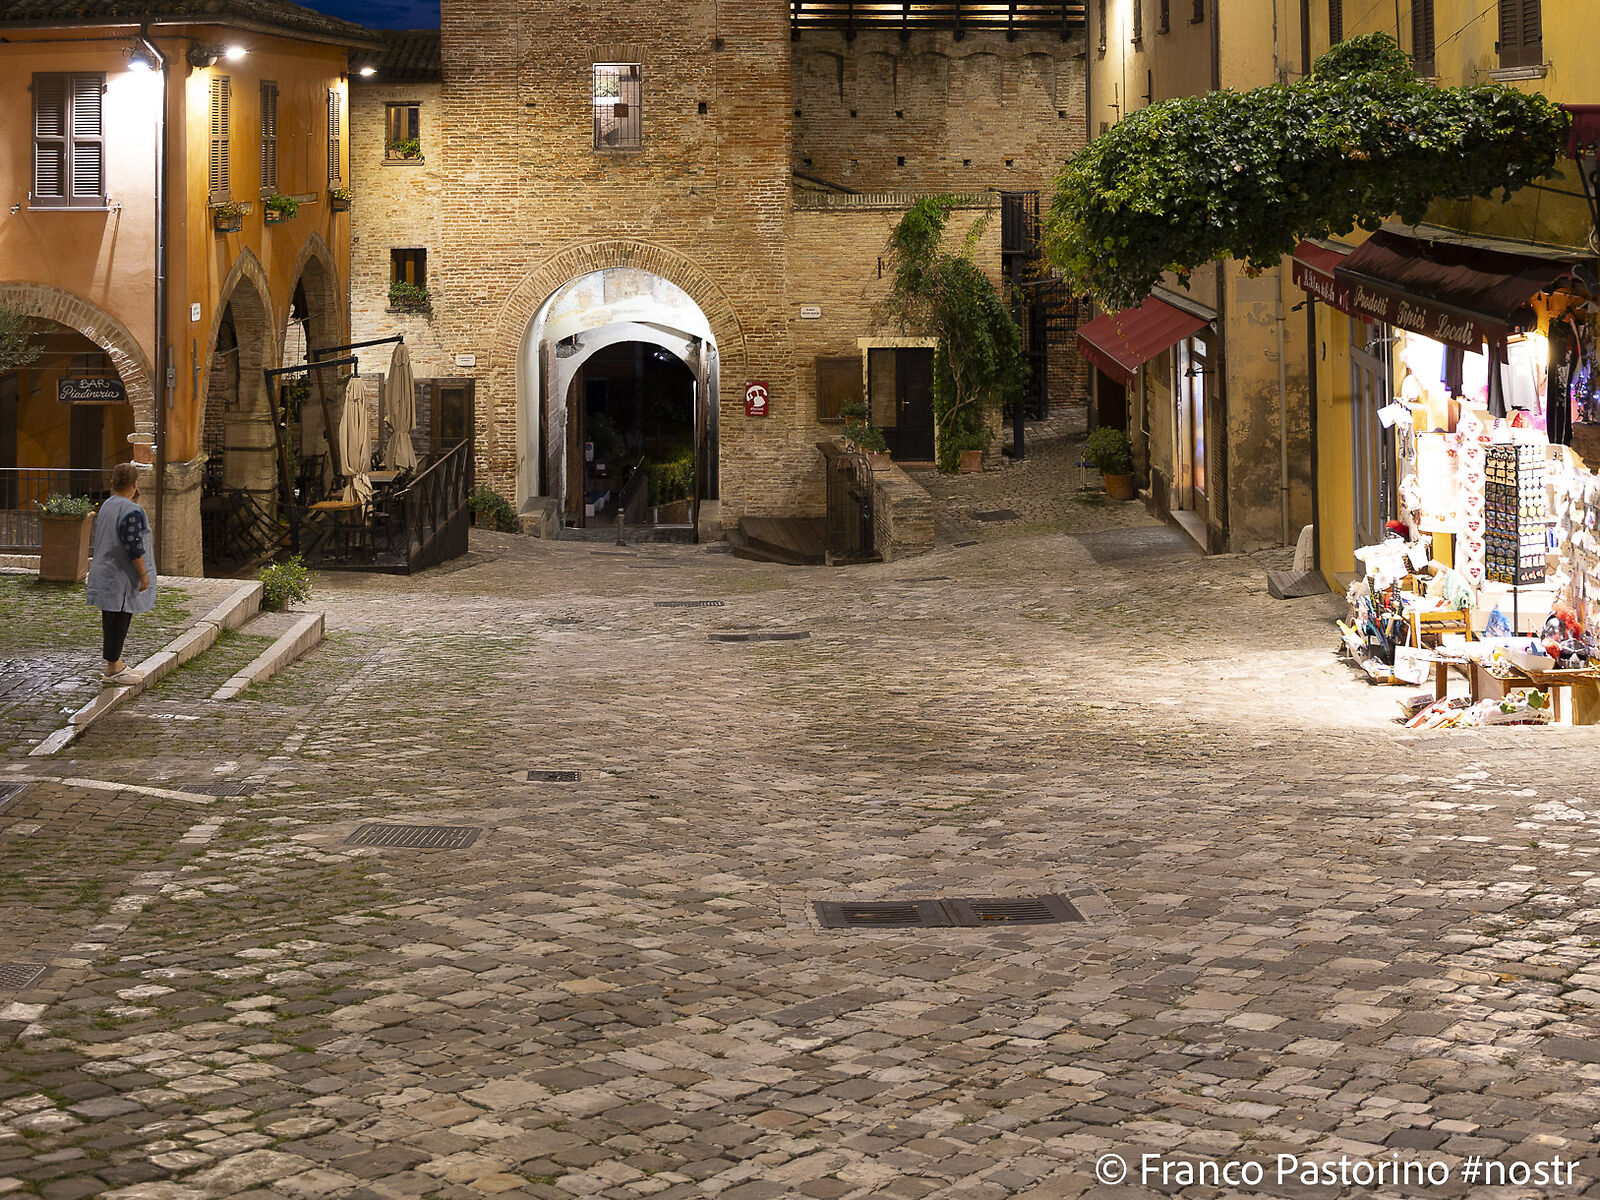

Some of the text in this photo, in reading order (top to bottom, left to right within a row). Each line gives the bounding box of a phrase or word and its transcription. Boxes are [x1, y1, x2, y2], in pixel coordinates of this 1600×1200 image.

[1396, 301, 1427, 330] Tipici
[1434, 313, 1475, 346] Locali
[80, 379, 110, 389] BAR
[60, 385, 119, 399] Piadineria
